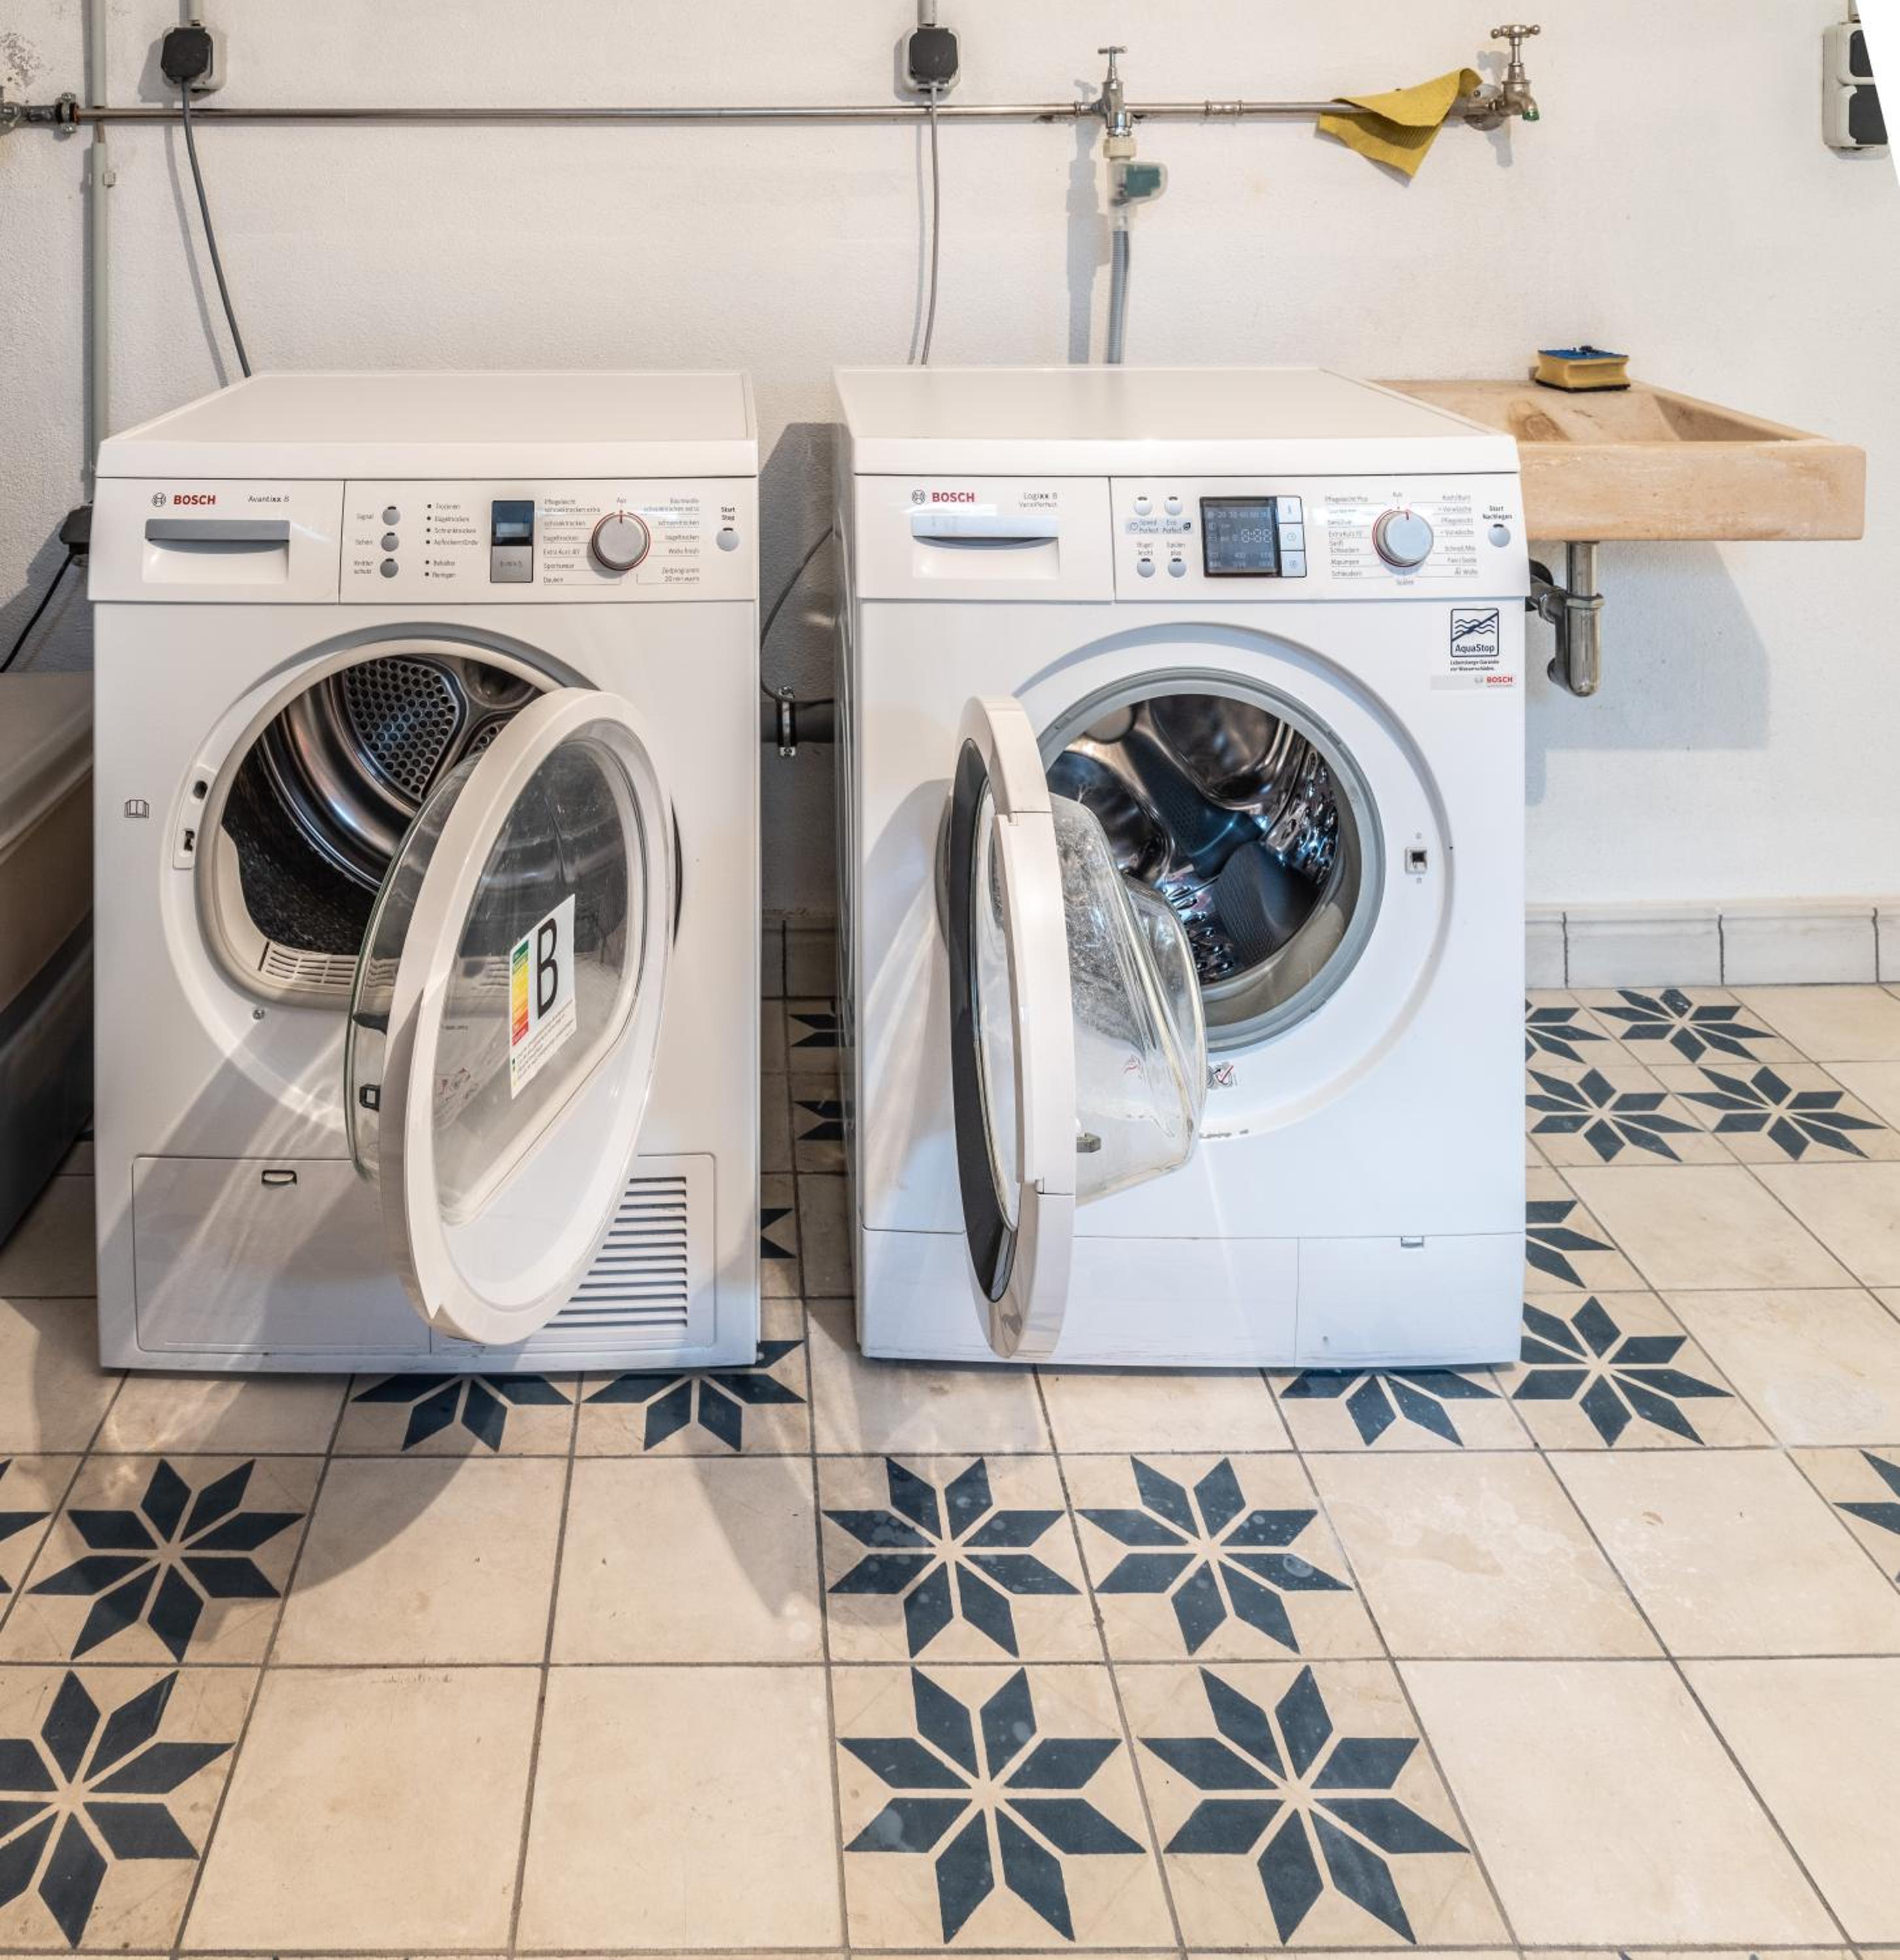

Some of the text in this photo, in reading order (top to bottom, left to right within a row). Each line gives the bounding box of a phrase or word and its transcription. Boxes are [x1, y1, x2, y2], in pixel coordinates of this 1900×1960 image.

[173, 495, 216, 505] BOSCH
[932, 492, 975, 502] BOSCH
[1024, 492, 1049, 501] Logixx
[1455, 644, 1495, 653] AquaStop
[536, 917, 558, 1020] B
